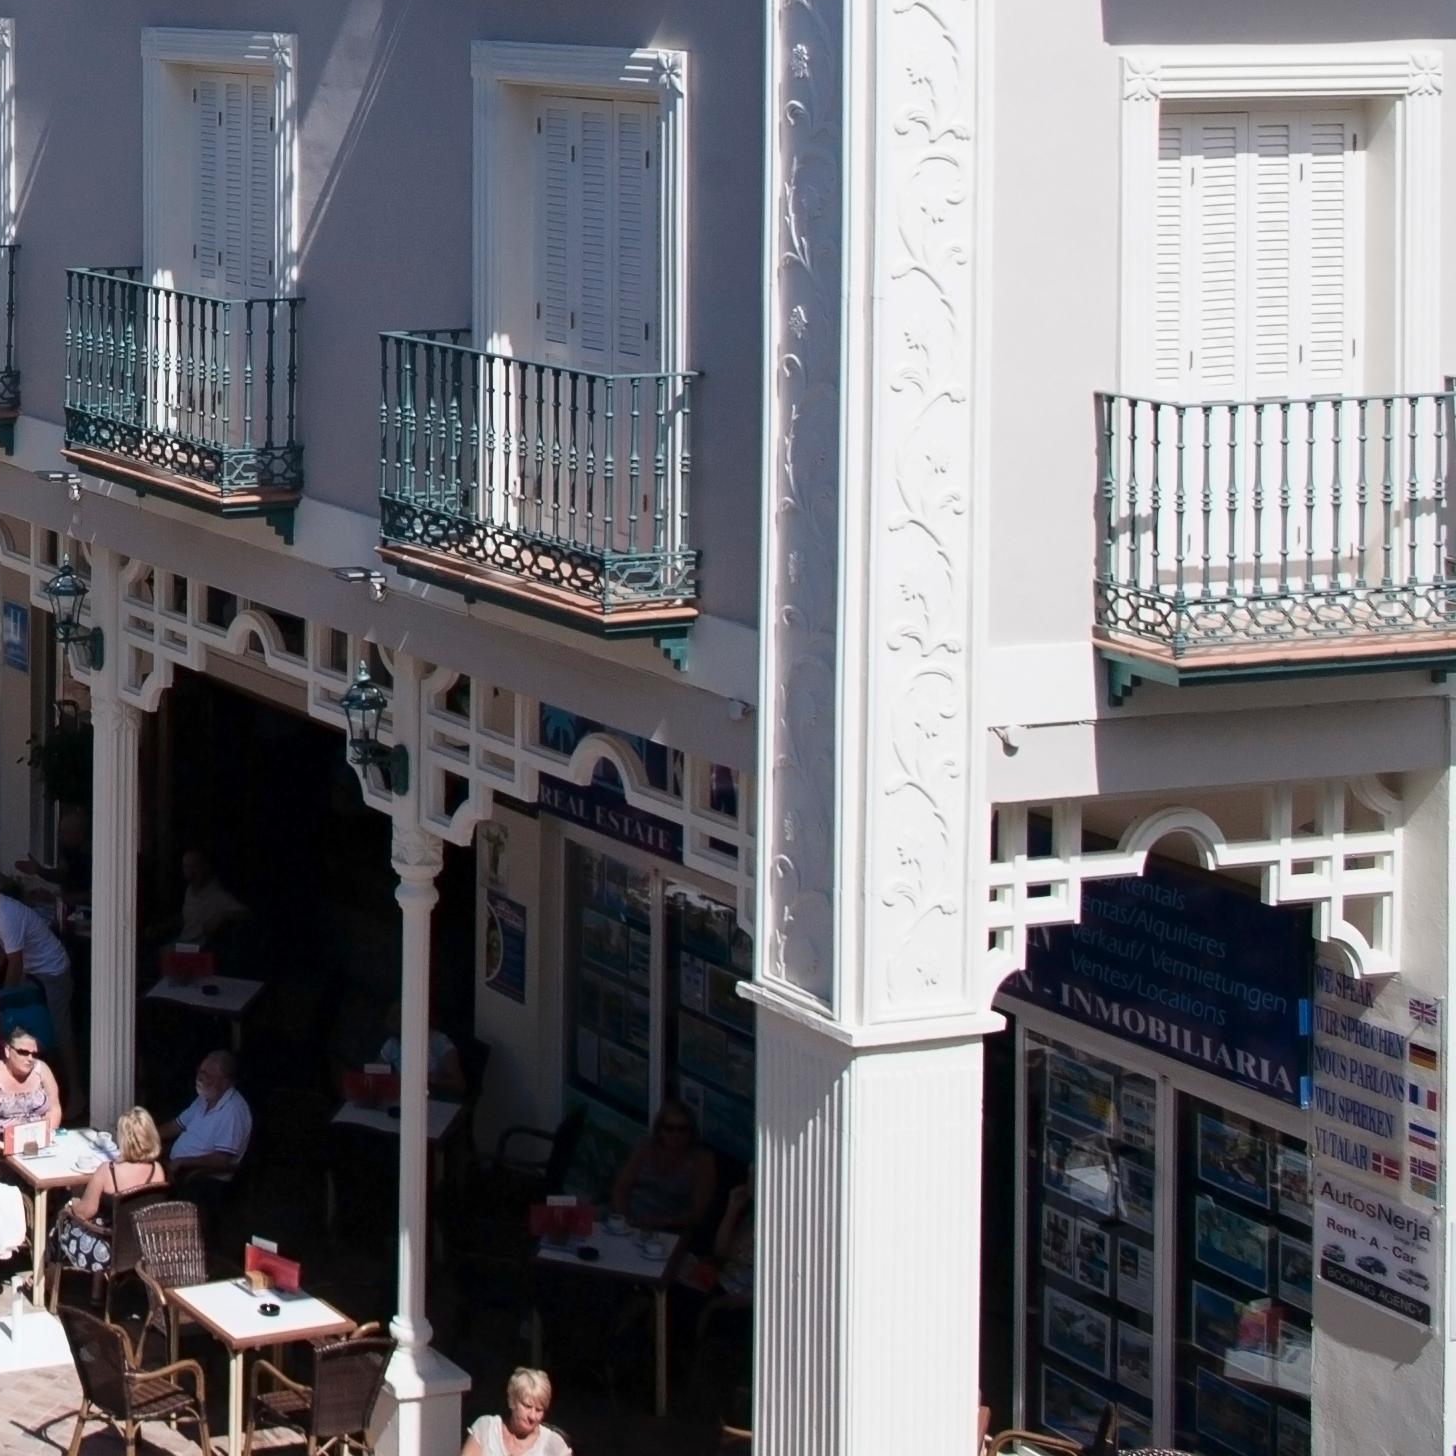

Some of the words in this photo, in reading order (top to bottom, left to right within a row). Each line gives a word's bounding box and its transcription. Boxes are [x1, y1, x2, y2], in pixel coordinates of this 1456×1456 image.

[539, 783, 588, 819] REAL
[595, 804, 672, 851] ESTATE
[1071, 949, 1227, 1027] Ventes/Locations
[1150, 946, 1288, 1015] Vermietungen
[1315, 964, 1334, 994] WE
[1335, 973, 1374, 1008] SPEAK
[1059, 981, 1294, 1093] INMOBILIARIA
[1315, 1005, 1338, 1036] WIR
[1340, 1017, 1405, 1059] SPRECHEN
[1314, 1045, 1346, 1081] NOUS
[1349, 1058, 1405, 1103] PARLONS
[1314, 1086, 1337, 1116] WIJ
[1338, 1097, 1395, 1139] SPREKEN
[1315, 1126, 1328, 1154] VI
[1329, 1132, 1368, 1171] TALAR
[1321, 1180, 1431, 1242] AutosNerja
[1326, 1217, 1357, 1240] Rent
[1369, 1236, 1380, 1250] A
[1392, 1246, 1417, 1265] Car
[1327, 1265, 1376, 1296] BOOKING
[1378, 1289, 1424, 1317] AGENCY
